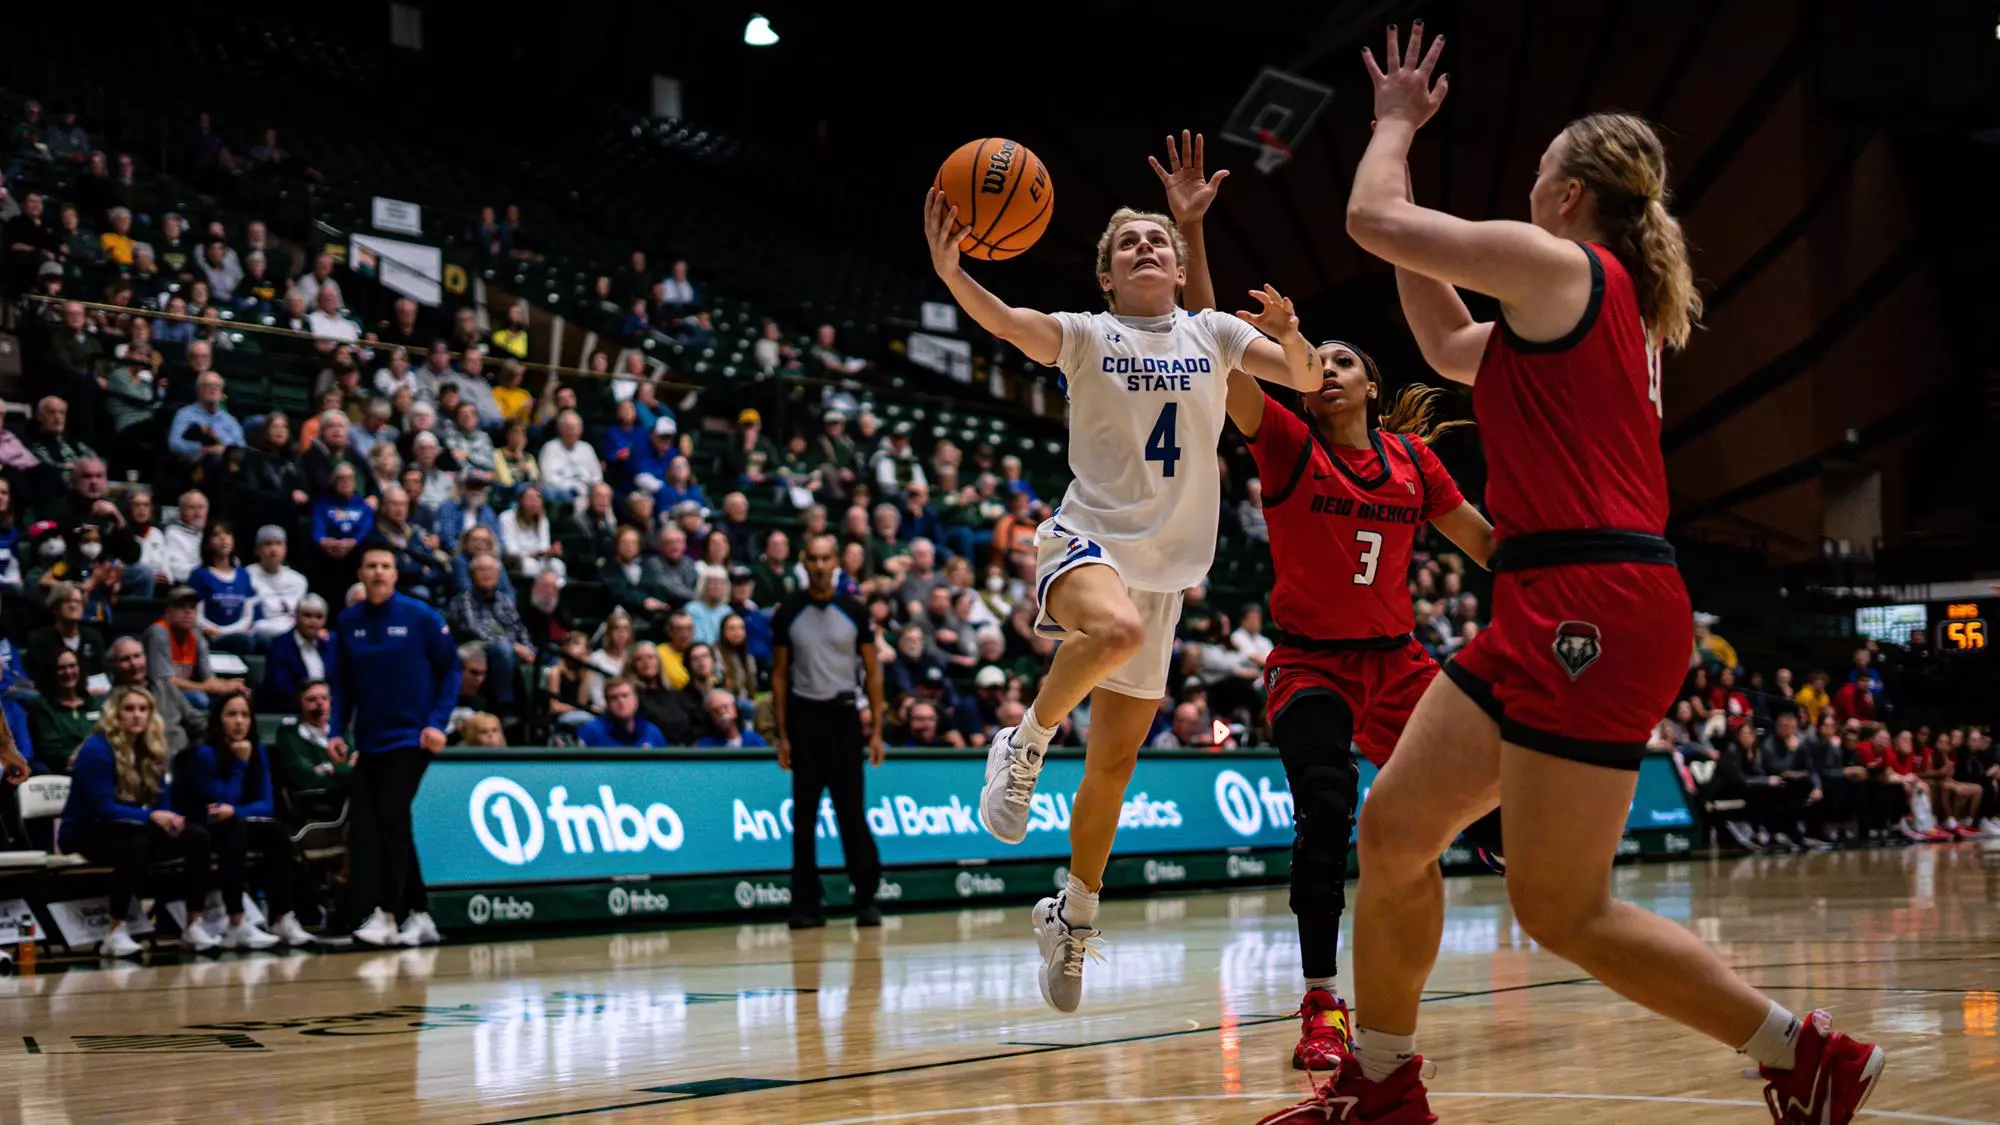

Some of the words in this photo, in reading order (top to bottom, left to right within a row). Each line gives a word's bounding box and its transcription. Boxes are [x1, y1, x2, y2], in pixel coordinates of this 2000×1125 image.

[1102, 356, 1211, 374] COLORADO
[1127, 374, 1192, 392] STATE
[1145, 402, 1182, 478] 4
[1310, 494, 1354, 517] NEW
[1352, 528, 1383, 587] 3
[547, 784, 685, 854] fnbo
[732, 798, 782, 842] An
[894, 795, 979, 836] Bank
[1027, 791, 1071, 832] SU
[493, 896, 535, 921] fnbo
